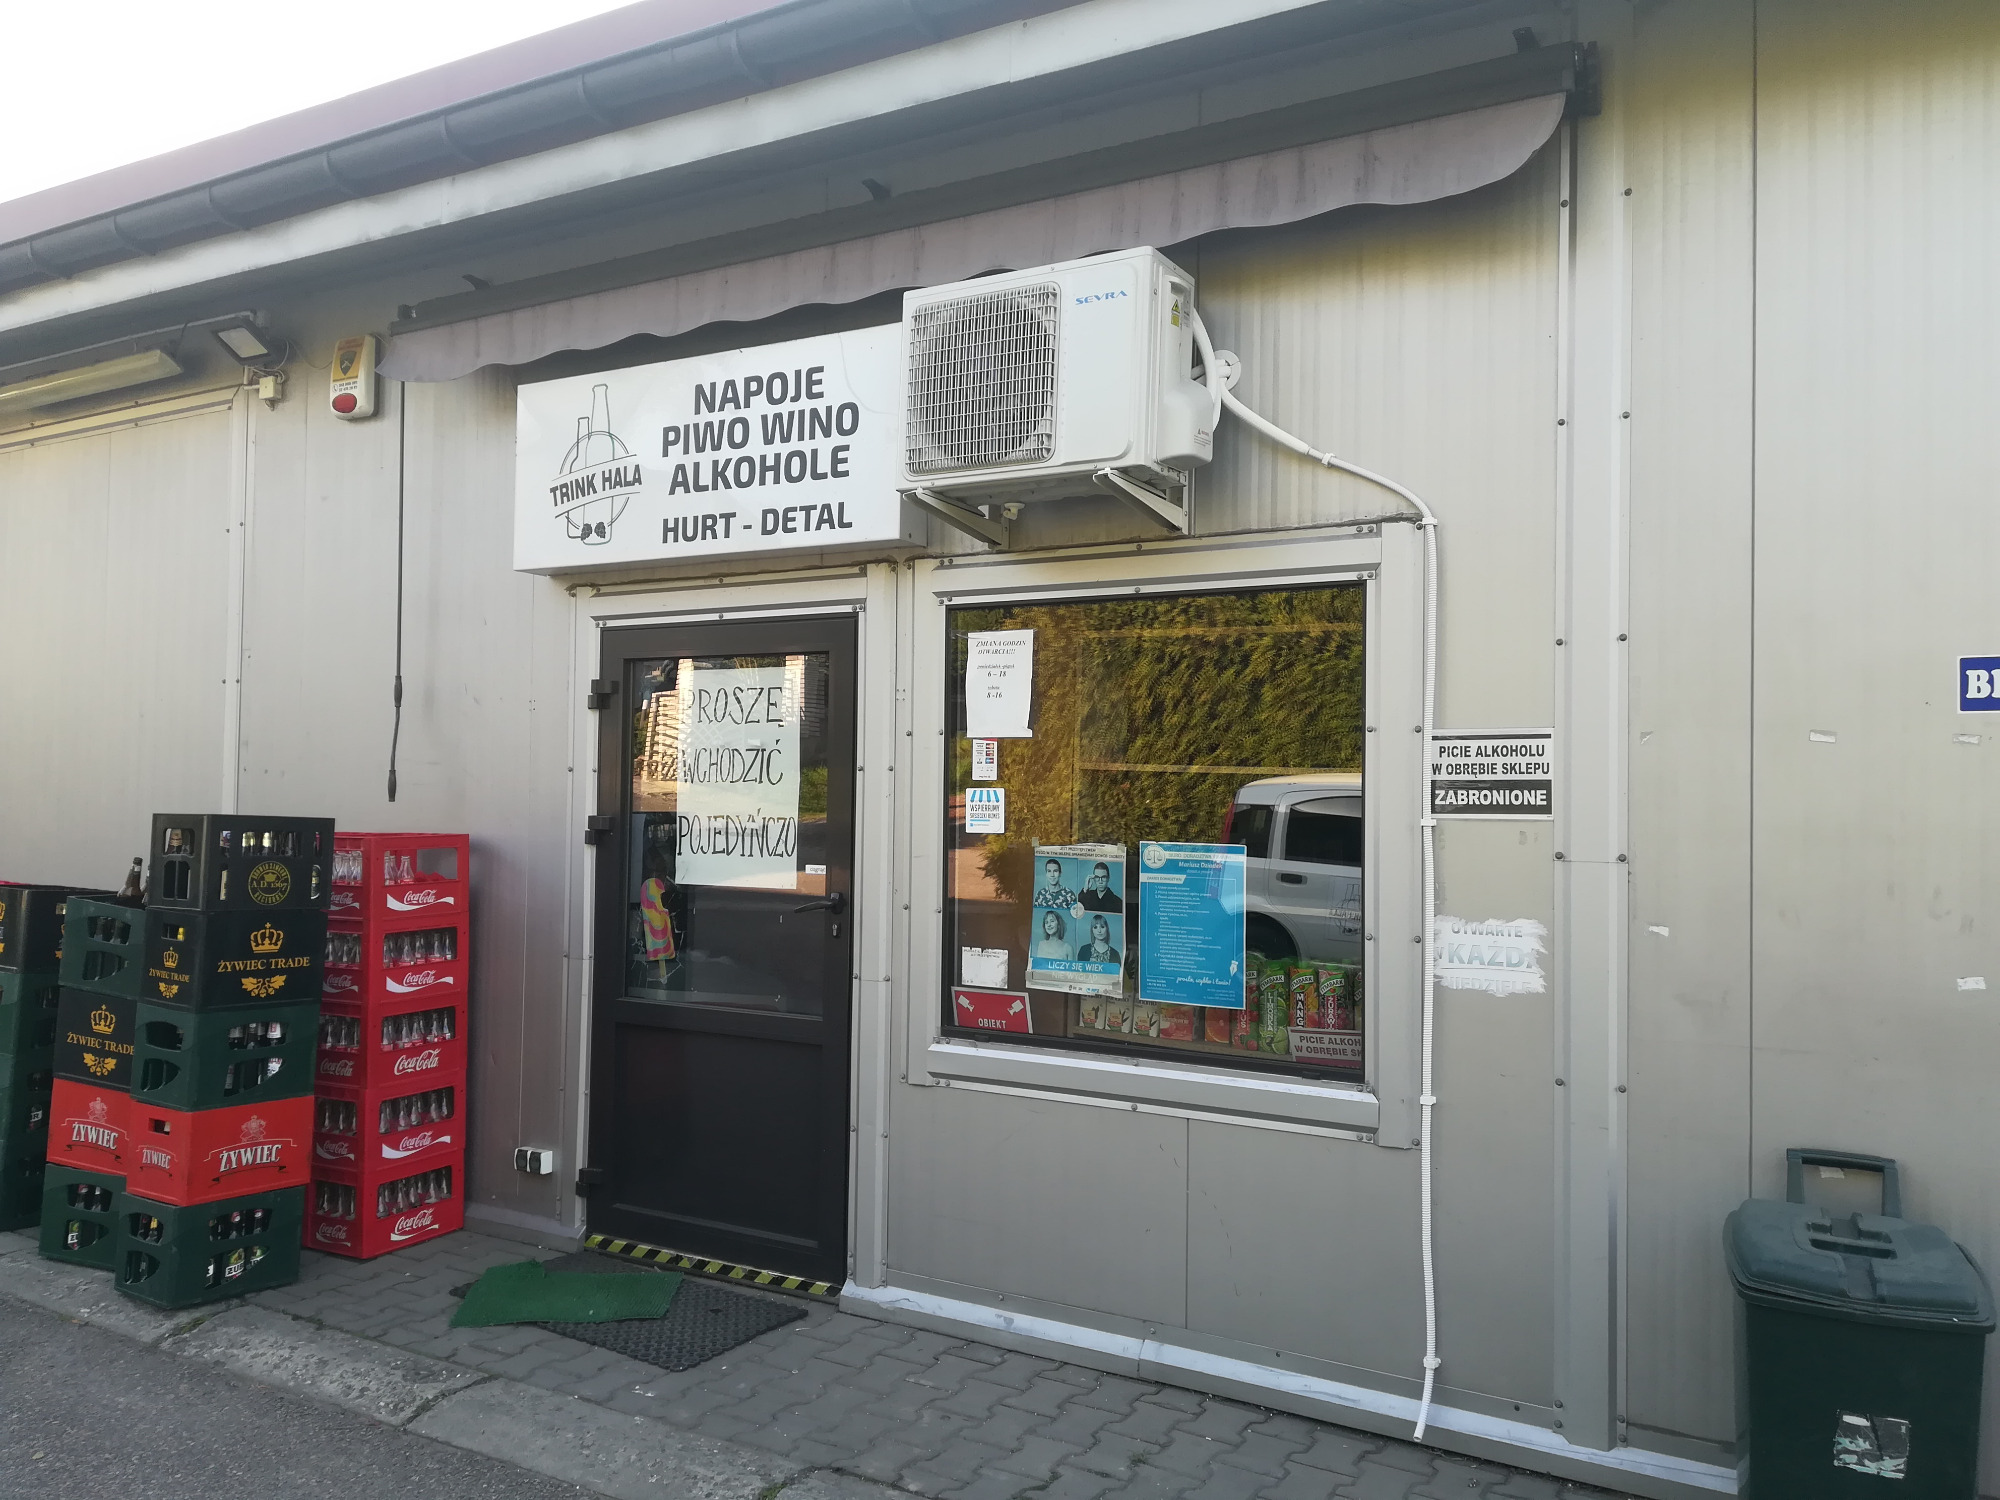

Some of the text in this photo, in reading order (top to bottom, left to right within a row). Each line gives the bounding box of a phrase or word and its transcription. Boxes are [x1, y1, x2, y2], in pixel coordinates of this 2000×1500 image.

[1075, 290, 1128, 305] SEVRA
[693, 366, 825, 415] NAPOJE
[661, 401, 860, 458] PIWO WINO
[668, 444, 851, 496] ALKOHOLE
[549, 463, 643, 509] TRINK HALA
[661, 510, 737, 544] HURT
[759, 500, 854, 534] DETAL
[1965, 668, 2000, 699] B
[1438, 744, 1545, 758] PICIE ALKOHOLU
[1432, 762, 1551, 778] W OBRĘBIE SKLEPU
[1434, 789, 1547, 806] ZABRONIONE
[404, 889, 437, 905] Coca-Cola
[1451, 922, 1523, 938] OTWARTE
[1448, 940, 1533, 969] KAŻD
[217, 956, 310, 973] ŻYWIEC TRADE
[1048, 961, 1104, 972] LICZY SIĘ WIEK
[149, 968, 190, 982] ŻYWIEC TRADE
[403, 969, 436, 986] Coca-Cola
[1051, 972, 1098, 983] NIE WYGLĄD
[1260, 975, 1284, 991] TYMBARK
[1320, 978, 1344, 995] TYMBARK
[1267, 992, 1275, 1032] LIMONKA
[1327, 995, 1335, 1030] ŻURAWI
[978, 1018, 1006, 1029] OBIEKT
[67, 1031, 102, 1049] ŻYWIEC
[1300, 1035, 1325, 1045] PICIE
[1294, 1045, 1303, 1053] W
[1305, 1046, 1349, 1056] OBRĘBIE
[320, 1057, 355, 1077] Coca-Cola
[394, 1048, 441, 1076] Coca-Cola
[72, 1122, 118, 1151] ŻYWIEC
[400, 1130, 434, 1151] Coca-Cola
[142, 1147, 171, 1170] ŻYWIEC
[219, 1144, 282, 1173] ŻYWIEC
[395, 1207, 434, 1235] Coca-Cola
